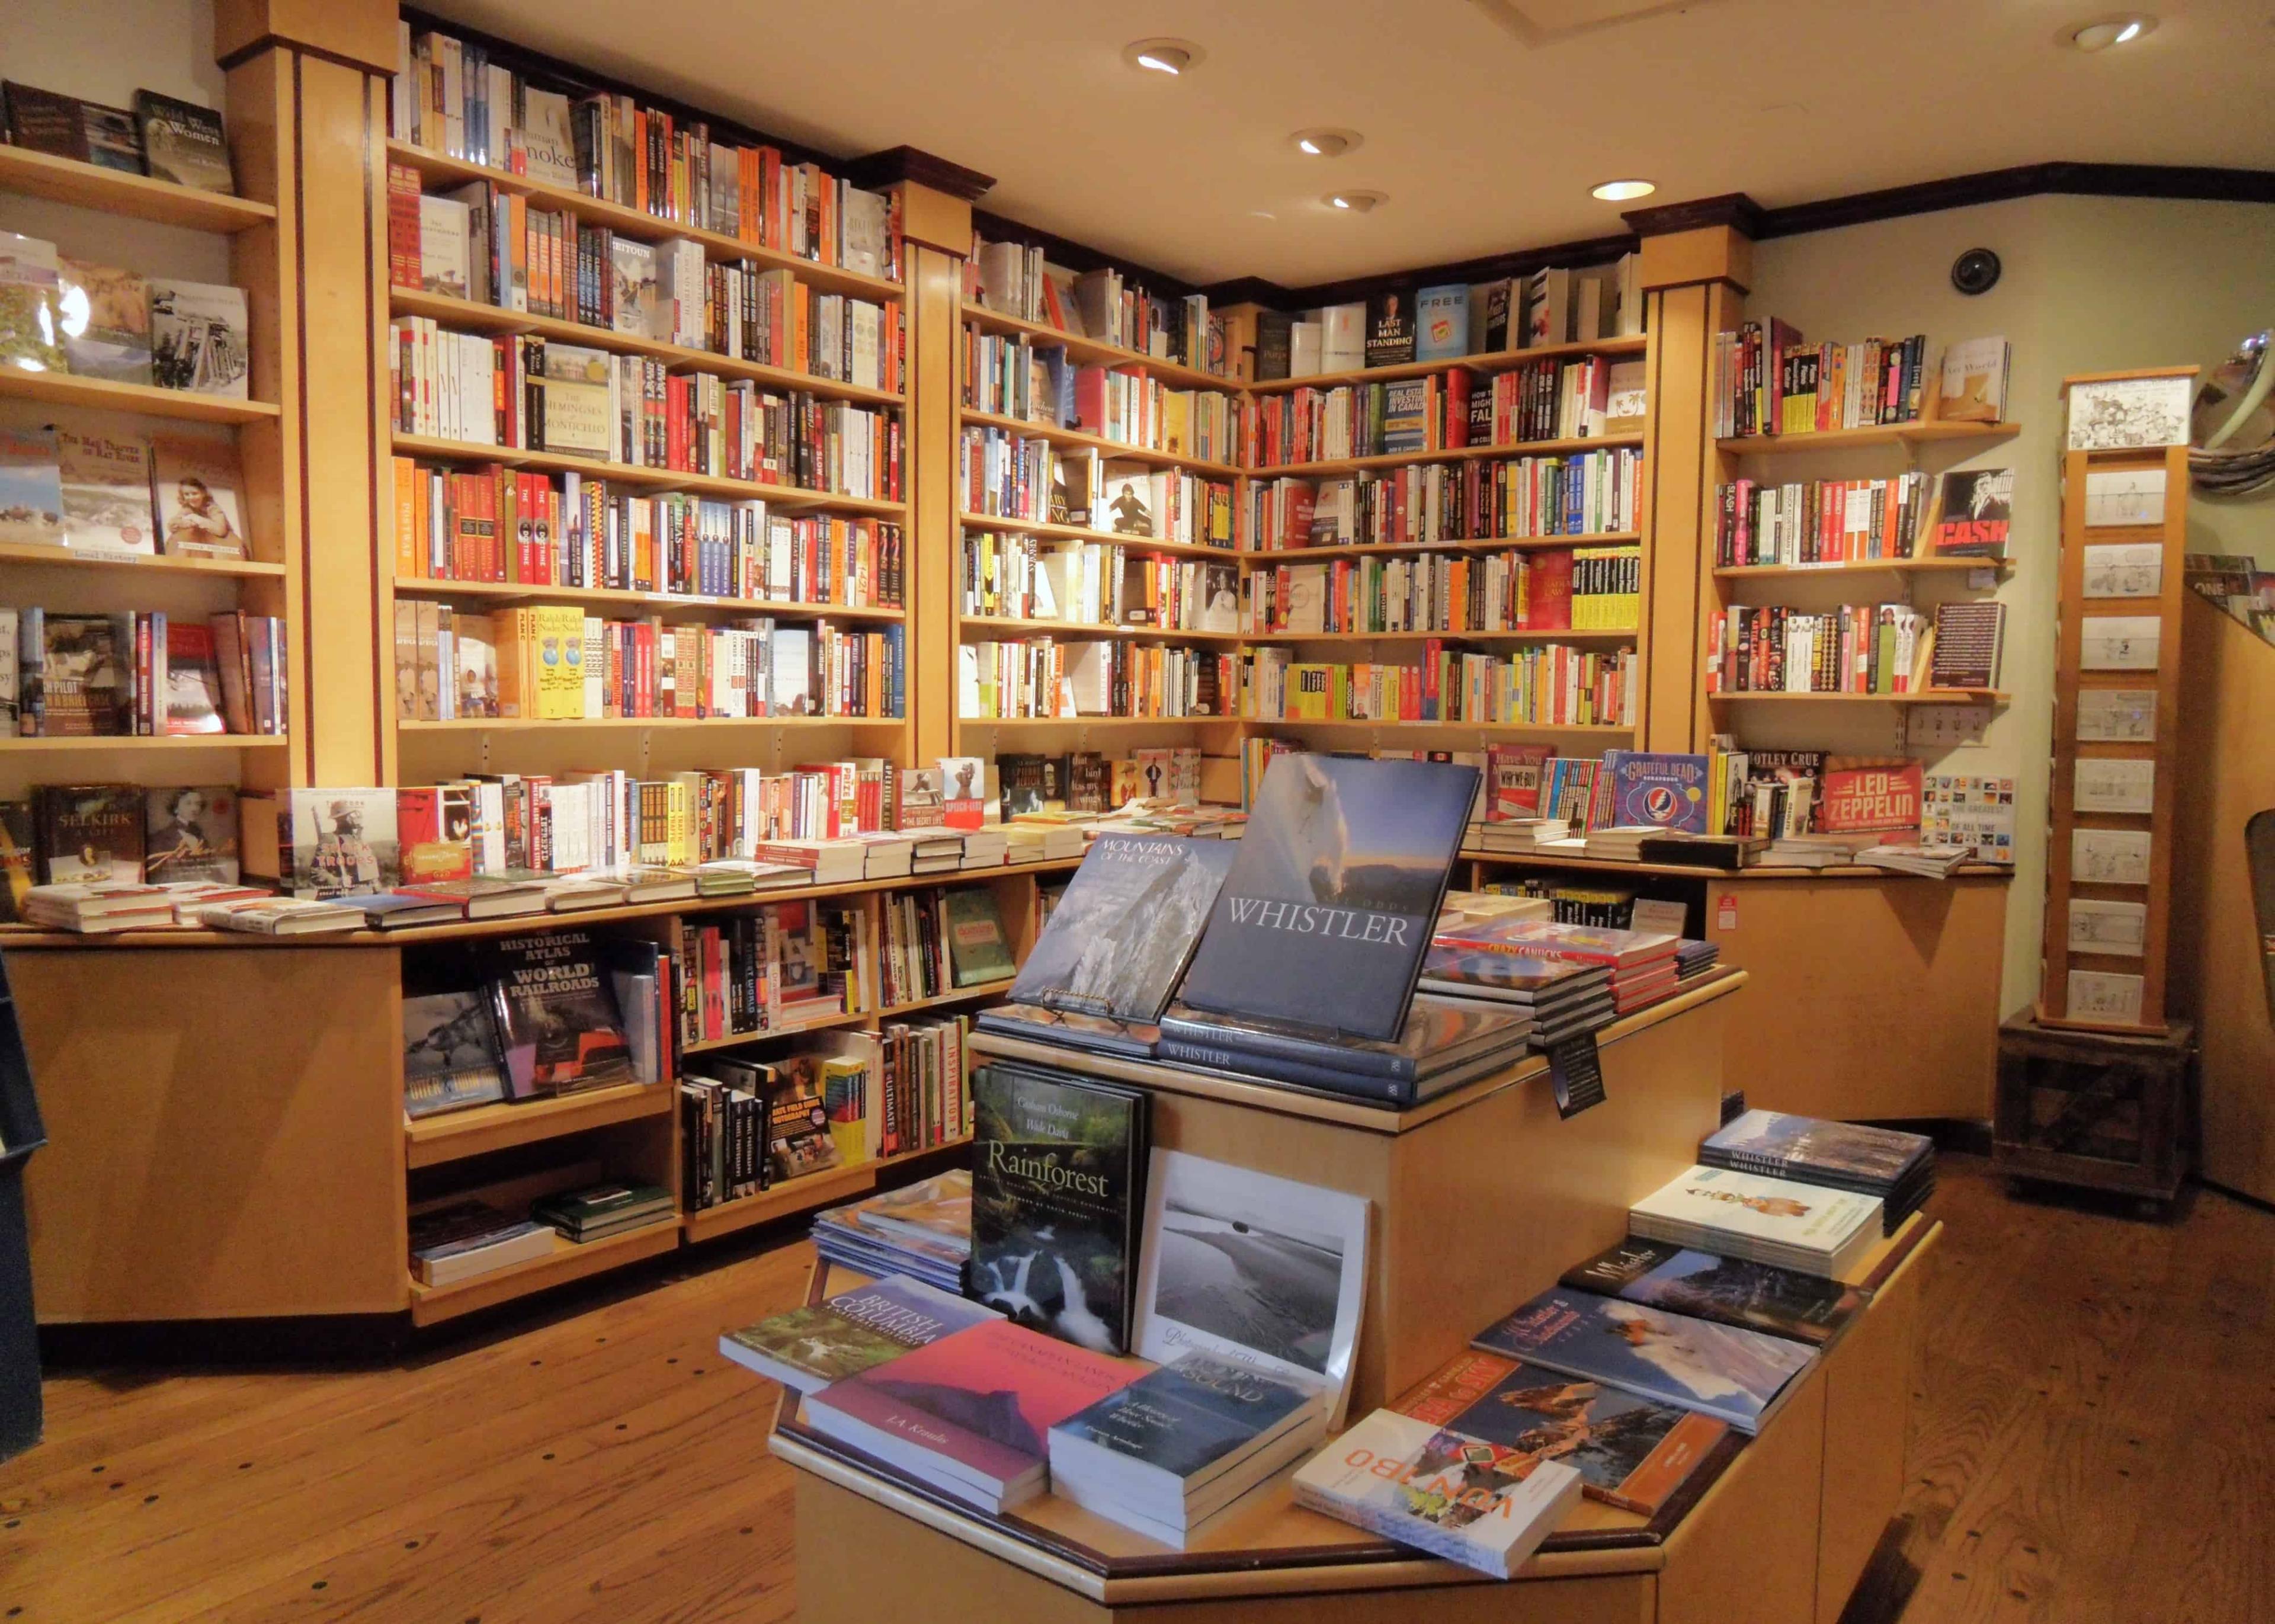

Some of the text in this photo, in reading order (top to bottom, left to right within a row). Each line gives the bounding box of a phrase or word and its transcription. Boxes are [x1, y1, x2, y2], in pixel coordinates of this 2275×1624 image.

[168, 121, 220, 146] Women
[1420, 296, 1465, 309] FREE
[1378, 318, 1401, 328] LAST
[1366, 335, 1412, 348] STANDING
[1378, 328, 1401, 338] MAN
[1388, 389, 1404, 398] REAL
[1388, 395, 1425, 405] INVESTIN
[1472, 391, 1486, 399] HOW
[1388, 405, 1396, 413] IN
[1726, 485, 1735, 512] SLASH
[675, 507, 683, 544] IDEAS
[1937, 520, 2010, 544] CASH
[1072, 754, 1088, 767] that
[1497, 753, 1520, 765] Have
[1791, 752, 1819, 767] CRUE
[1084, 767, 1101, 779] bird
[1501, 771, 1536, 787] WHY WE BUY
[1627, 761, 1694, 783] GRATEFUL DEAD
[843, 767, 851, 797] PRIZE
[1072, 781, 1098, 794] has my
[1854, 773, 1889, 797] LED
[1078, 793, 1101, 808] wings
[1829, 793, 1914, 821] ZEPPELIN
[59, 813, 133, 826] SELKIRK
[906, 817, 915, 826] THE
[917, 817, 931, 826] SECRET
[540, 815, 549, 861] INTREPID
[1102, 838, 1184, 856] MOUNTAINS
[1100, 851, 1112, 861] OF
[1138, 855, 1171, 865] COAST
[1229, 896, 1408, 946] WHISTLER
[500, 933, 589, 952] HISTORICAL
[1488, 943, 1562, 960] CRAZY CANUCKS
[525, 946, 571, 961] ATLAS
[512, 963, 589, 985] WORLD
[510, 976, 600, 997] RAILROADS
[1169, 1020, 1234, 1043] WHISTLER
[1167, 1042, 1231, 1066] WHISTLER
[948, 1046, 956, 1122] INSPIRATION
[886, 1080, 895, 1126] ULTIMATE
[988, 1139, 1109, 1197] Rainforest
[1729, 1159, 1786, 1177] WHISTLER
[1731, 1149, 1789, 1169] WHISTLER
[830, 1295, 937, 1344] COLUMBIA
[859, 1294, 944, 1331] BRITISH
